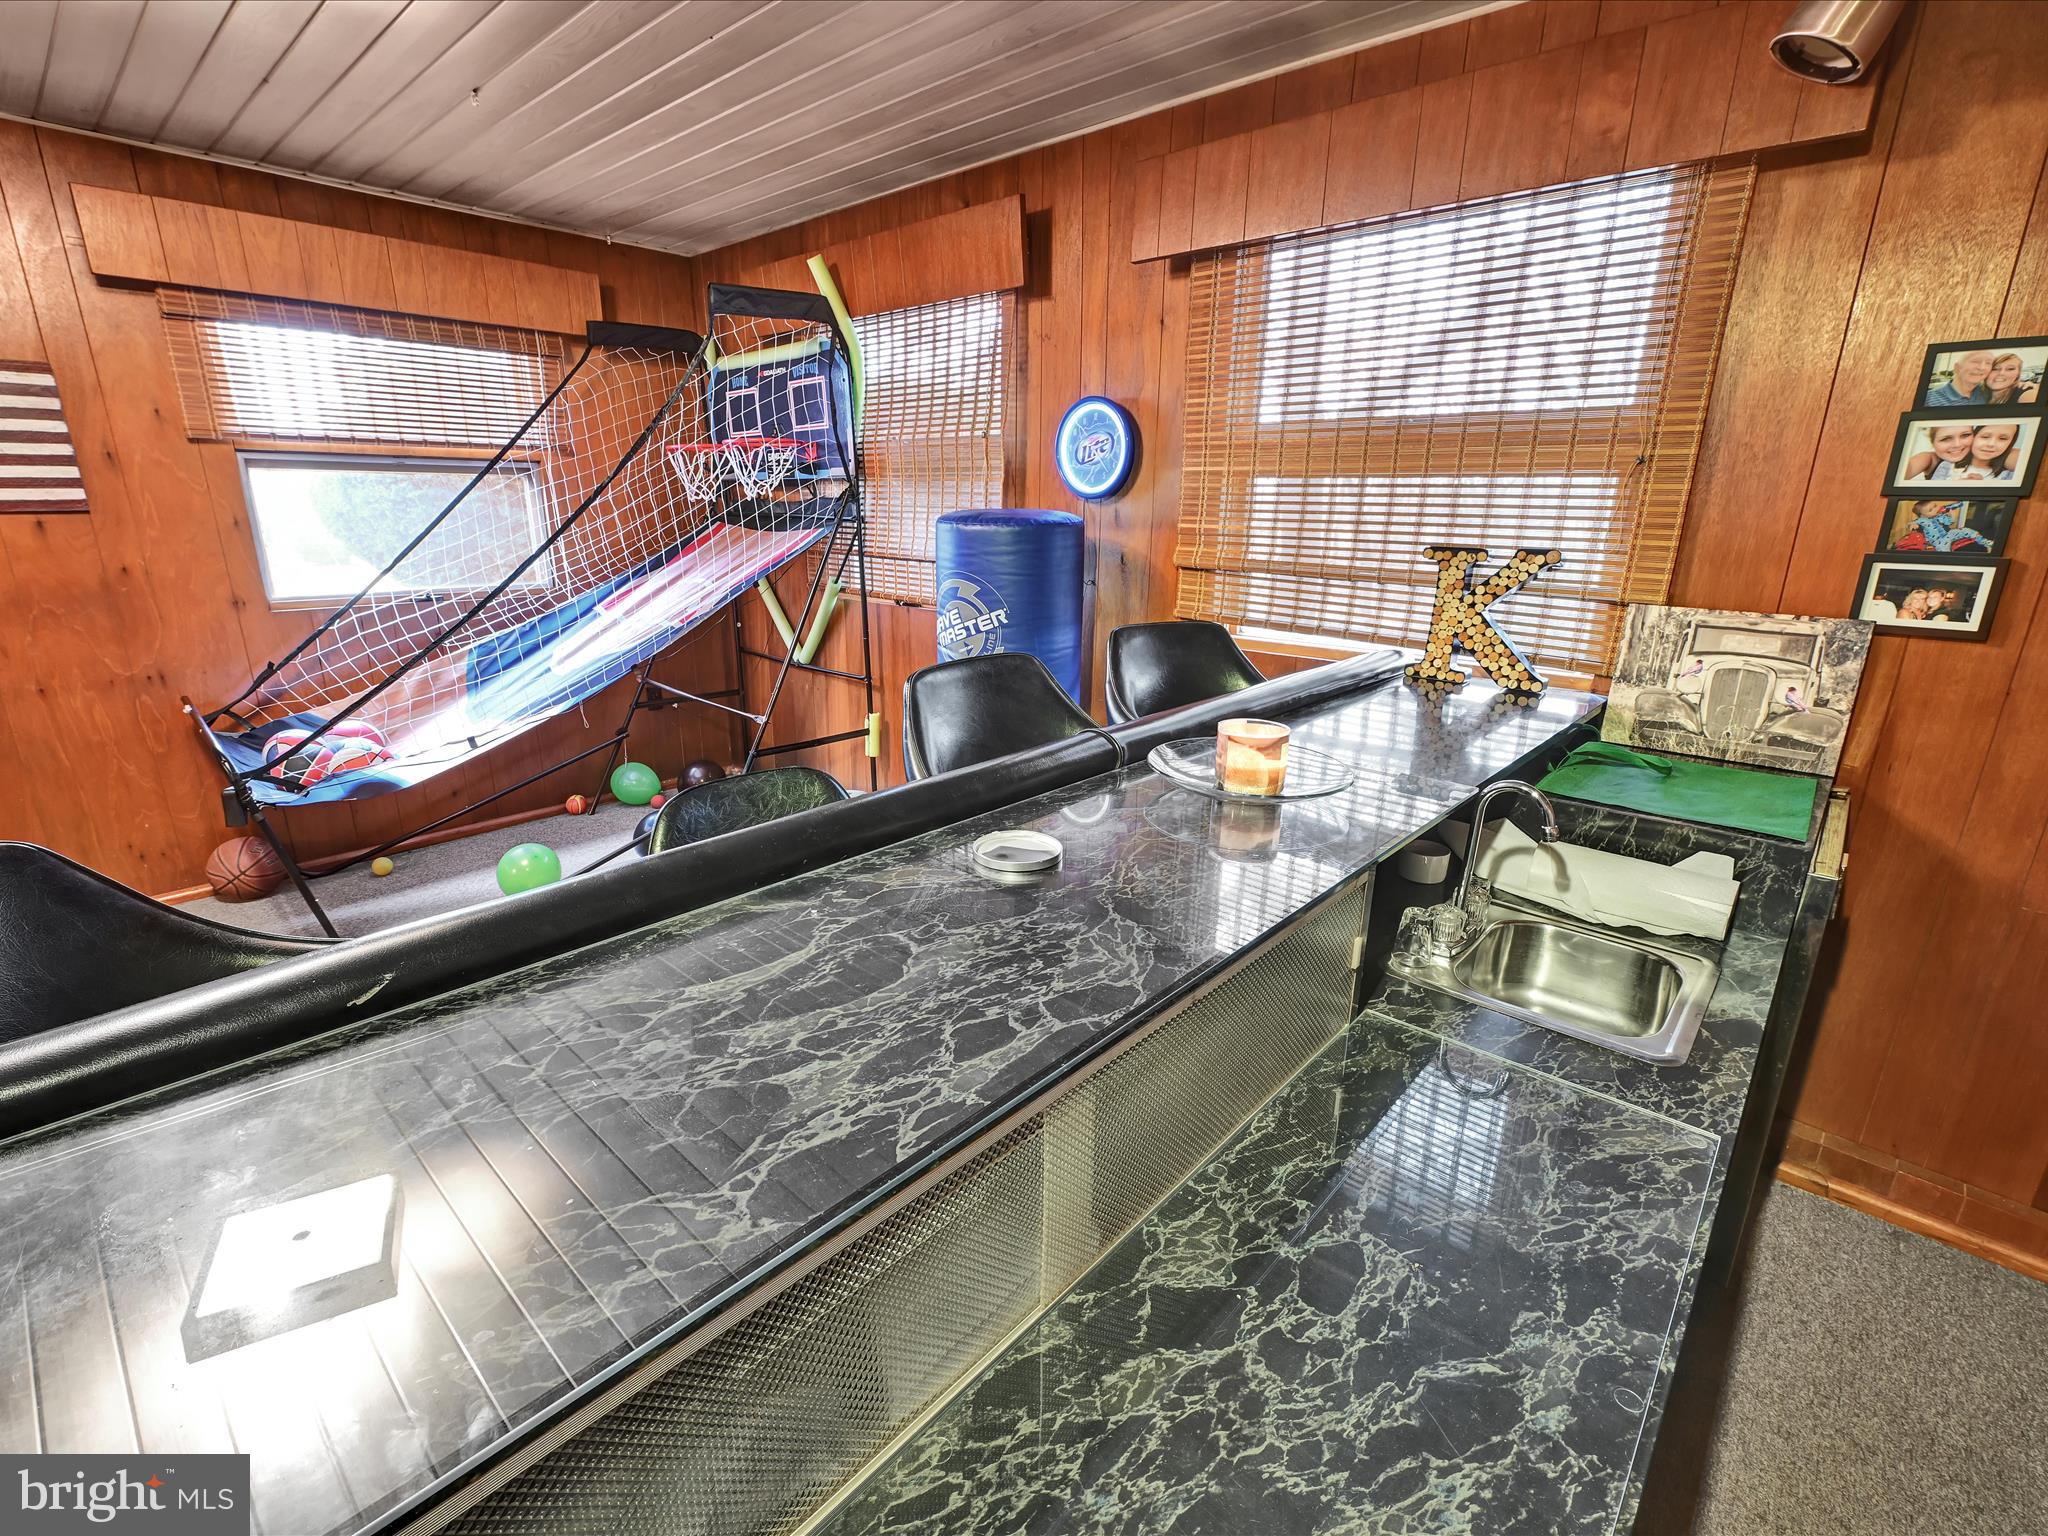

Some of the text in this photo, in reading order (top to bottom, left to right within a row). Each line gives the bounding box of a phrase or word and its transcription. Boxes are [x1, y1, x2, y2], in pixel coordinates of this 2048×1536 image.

[731, 375, 749, 389] HOME
[792, 362, 819, 378] VISITOR
[937, 608, 962, 635] AVE
[939, 608, 1009, 647] MASTER
[1404, 547, 1562, 693] K
